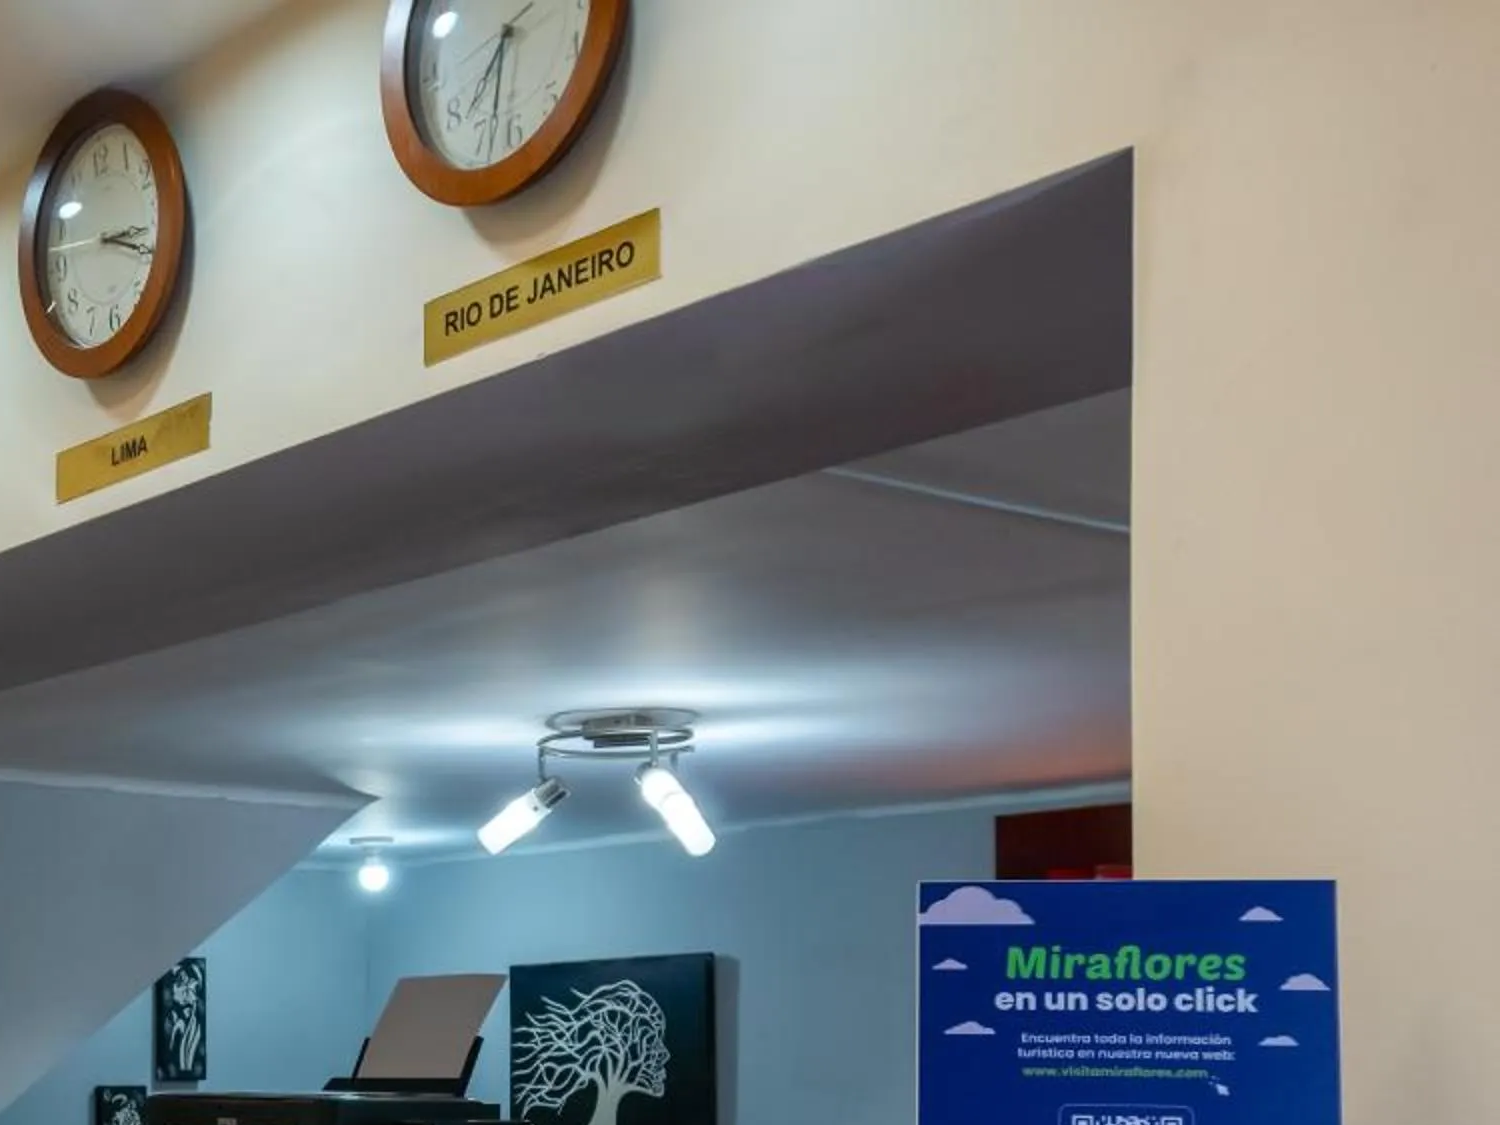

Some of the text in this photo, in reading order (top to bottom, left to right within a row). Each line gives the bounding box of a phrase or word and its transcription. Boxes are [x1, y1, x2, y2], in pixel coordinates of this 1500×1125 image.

[443, 240, 636, 337] RIO DE JANEIRO
[110, 435, 149, 467] LIMA
[1005, 944, 1247, 982] Miraflores
[993, 987, 1259, 1014] en un solo click
[1020, 1032, 1232, 1046] Encuentra toda la información
[1077, 1049, 1094, 1060] en
[1097, 1048, 1152, 1060] nuestra
[1154, 1049, 1199, 1061] nueva
[1021, 1065, 1209, 1079] www.visitamiraflores.com
